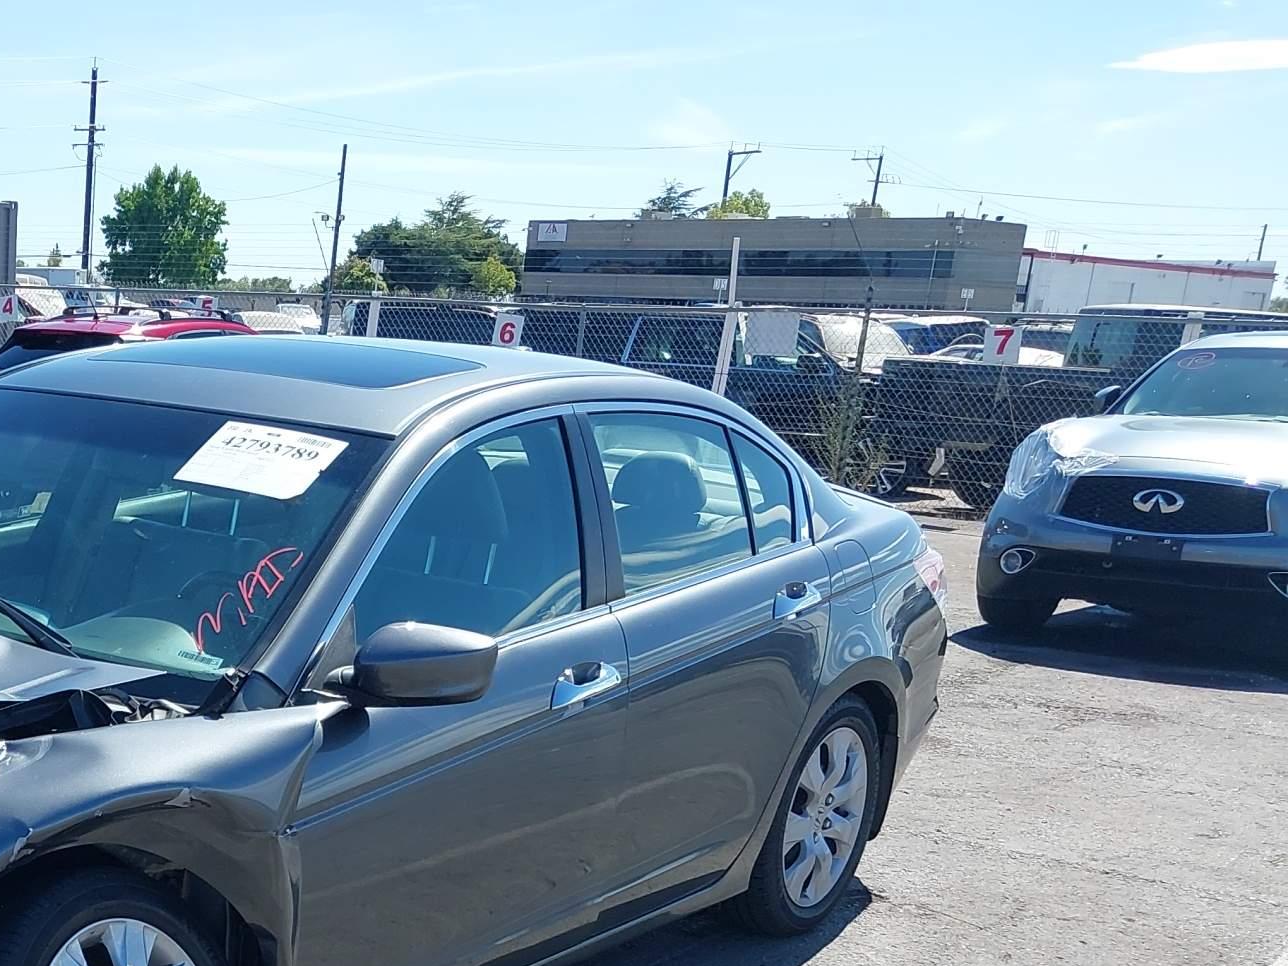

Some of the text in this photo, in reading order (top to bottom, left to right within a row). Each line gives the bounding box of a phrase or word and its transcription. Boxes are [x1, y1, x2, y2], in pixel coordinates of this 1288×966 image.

[2, 297, 13, 315] 4
[201, 297, 213, 317] 5
[499, 322, 516, 344] 6
[993, 328, 1015, 355] 7
[221, 435, 320, 461] 42793789
